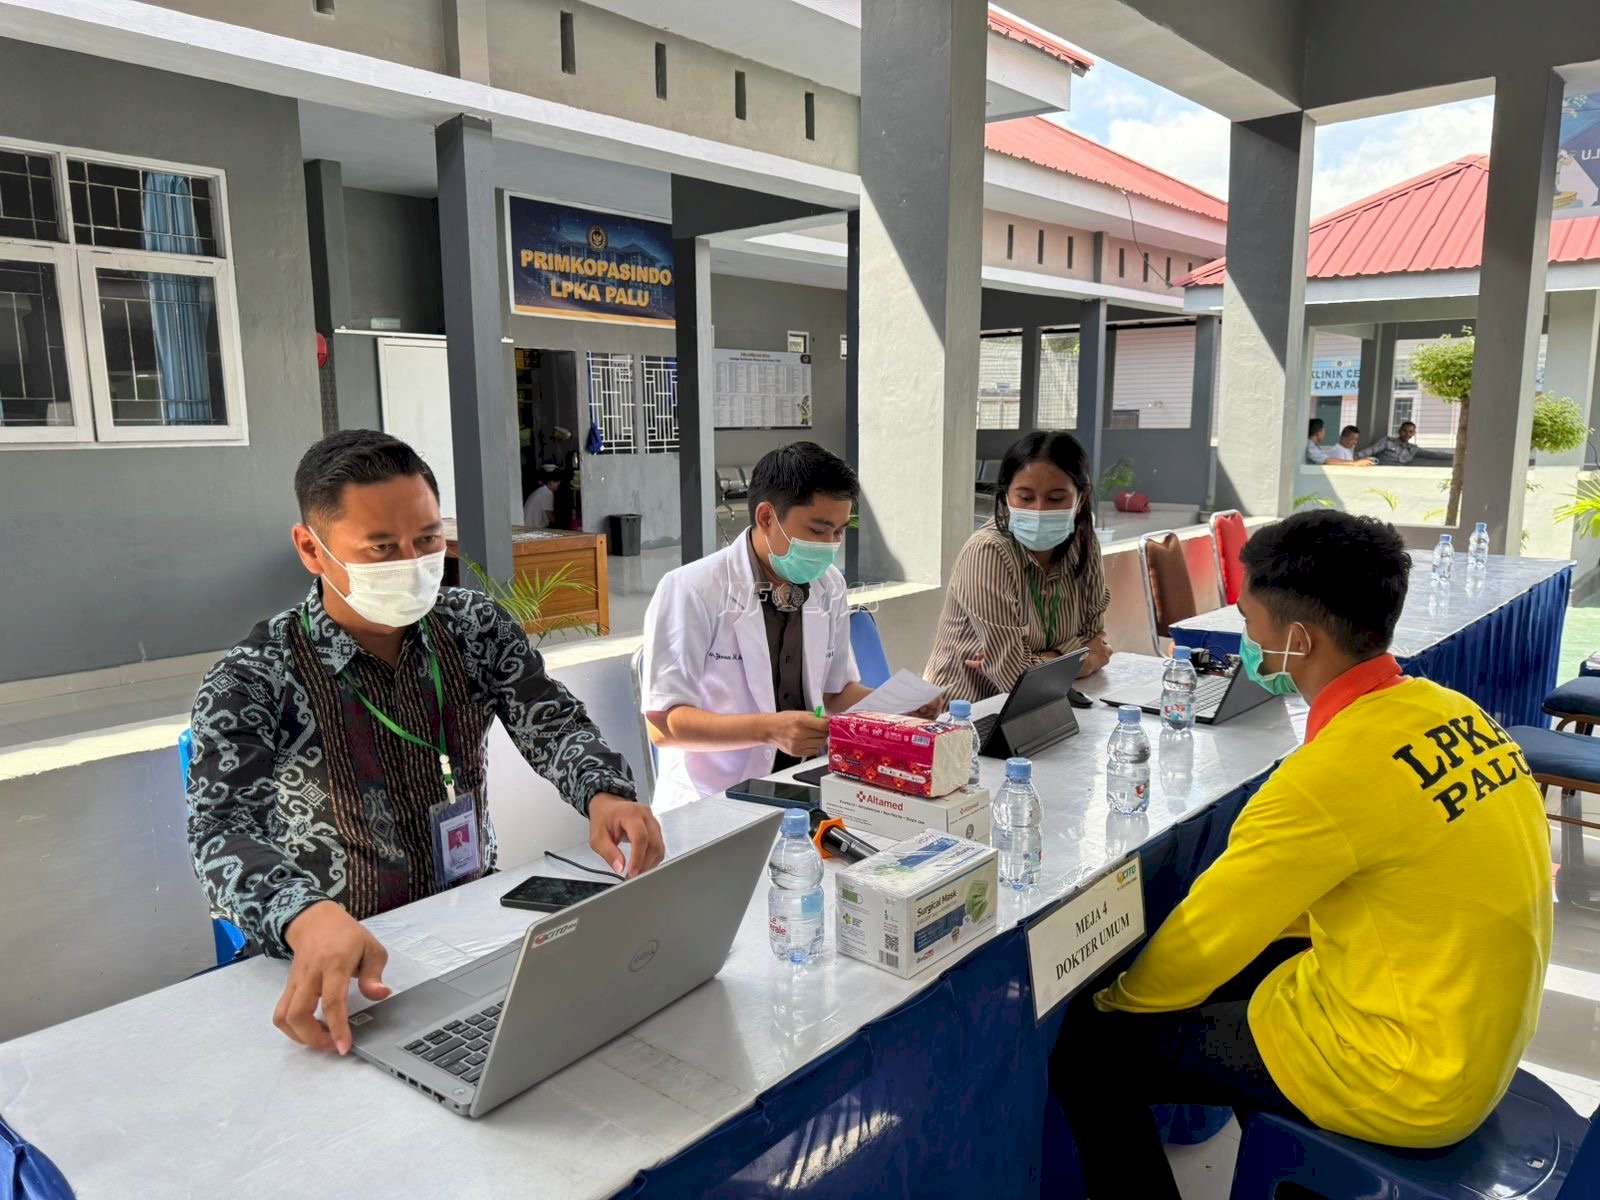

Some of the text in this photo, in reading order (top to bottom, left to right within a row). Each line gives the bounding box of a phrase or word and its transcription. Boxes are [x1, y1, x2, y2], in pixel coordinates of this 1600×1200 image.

[521, 249, 672, 286] PRIMKOPASINDO
[550, 279, 650, 307] LPKA PALU
[1315, 380, 1341, 390] LPKA
[1391, 709, 1512, 790] LPKA
[866, 794, 904, 811] Altamed
[1432, 749, 1531, 823] PALU
[917, 897, 941, 918] Surgical
[941, 889, 957, 904] Mask
[1075, 900, 1108, 937] MEJA 4
[1055, 913, 1130, 981] DOKTER UMUM
